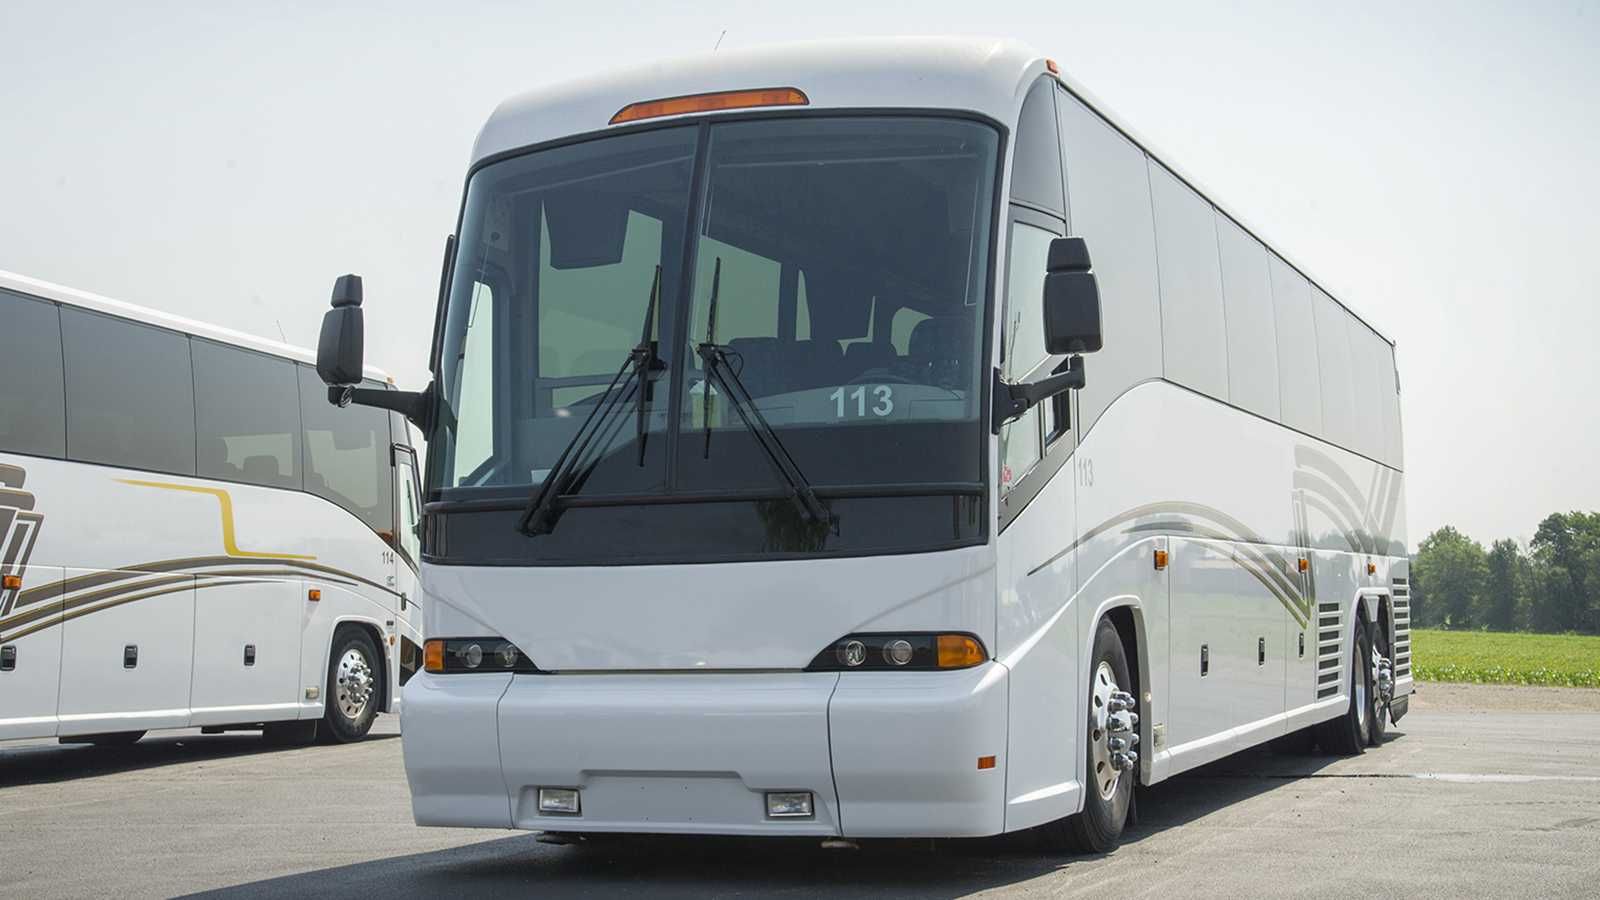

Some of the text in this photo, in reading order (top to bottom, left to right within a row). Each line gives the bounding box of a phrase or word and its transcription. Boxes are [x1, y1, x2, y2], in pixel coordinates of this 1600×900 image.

[830, 385, 894, 417] 113
[1079, 458, 1095, 487] 113
[382, 551, 394, 565] 114
